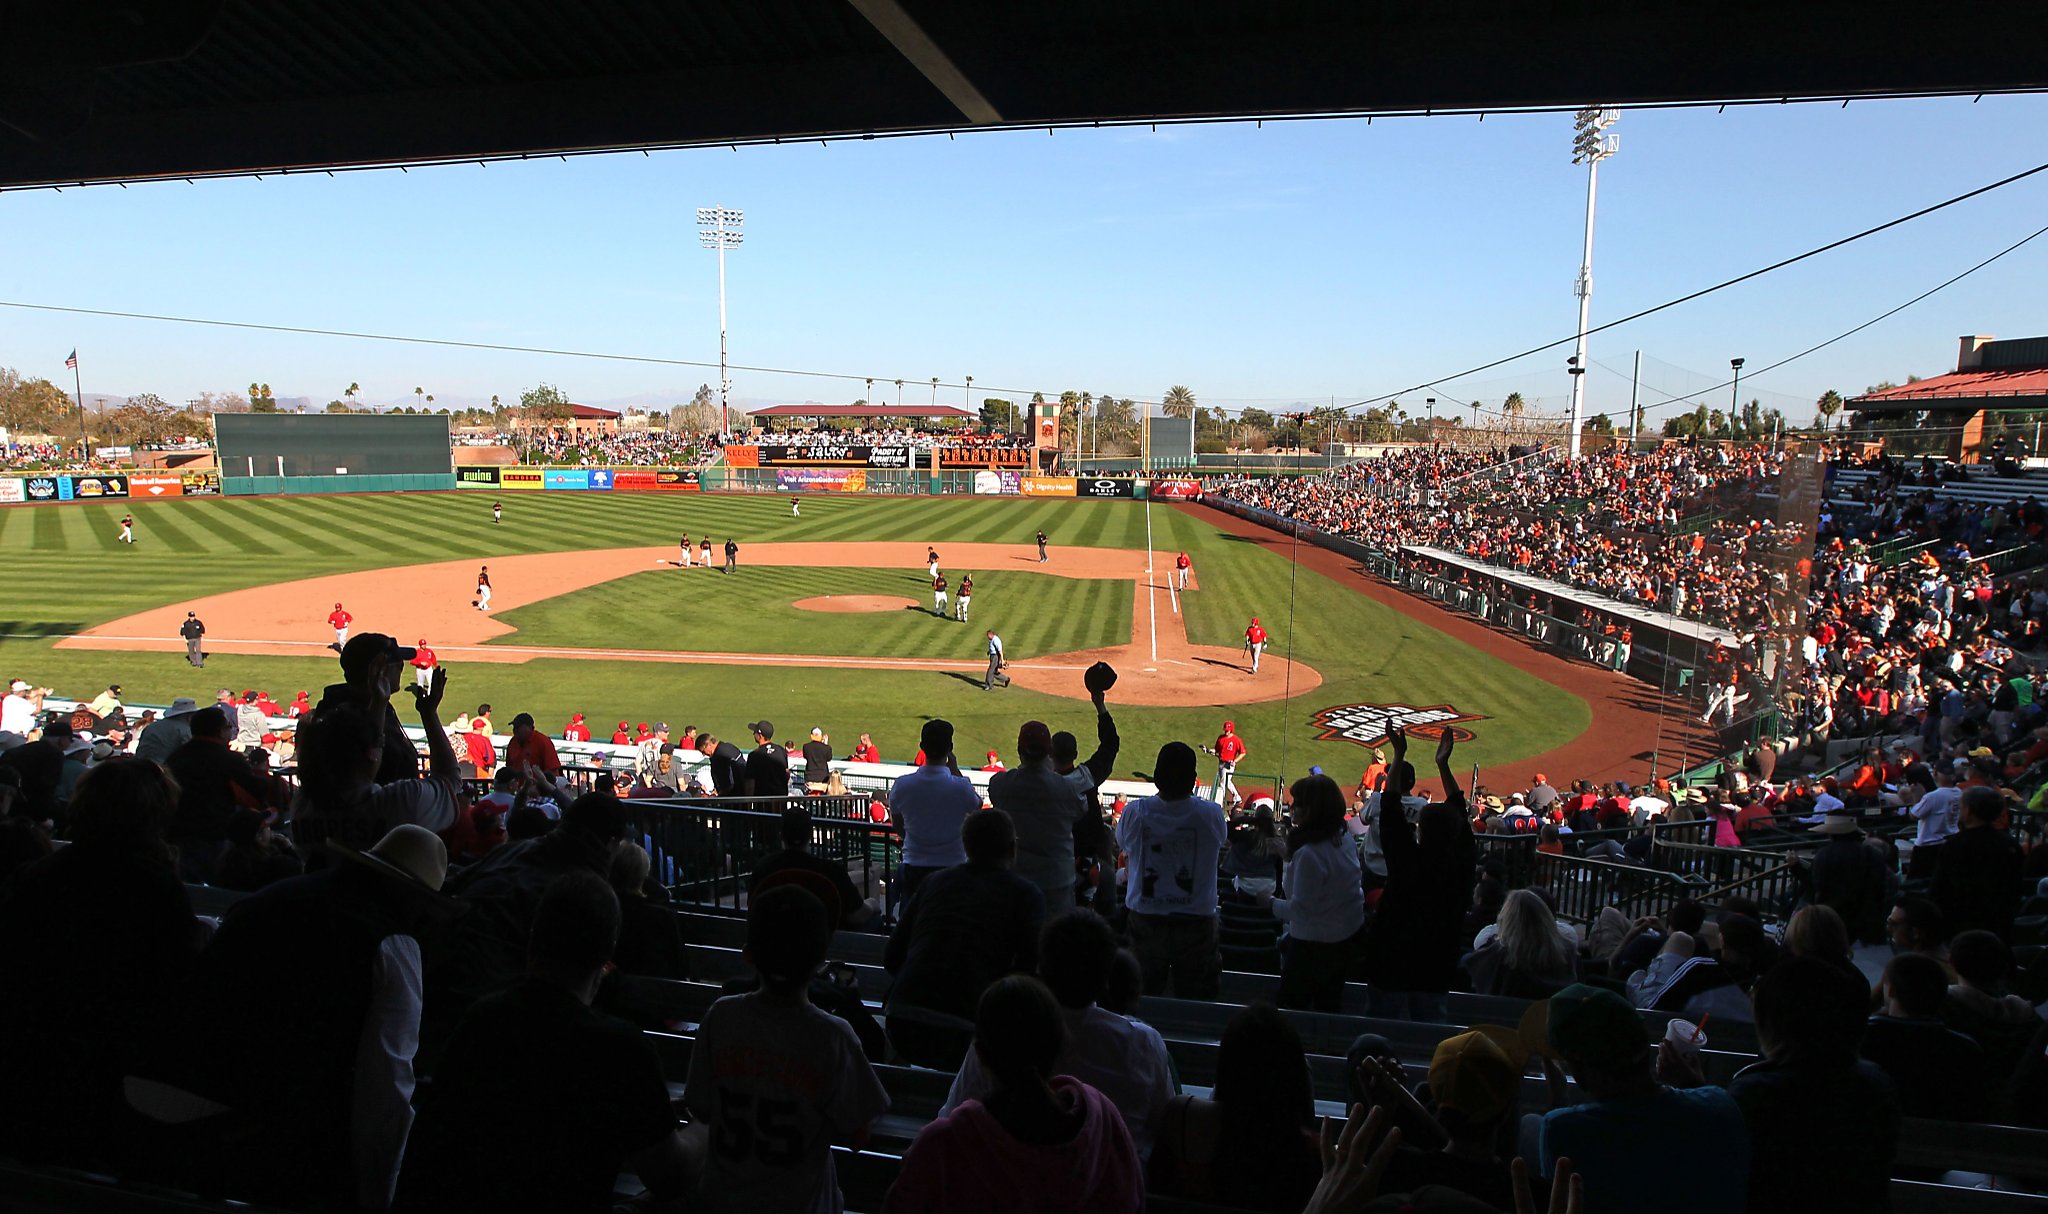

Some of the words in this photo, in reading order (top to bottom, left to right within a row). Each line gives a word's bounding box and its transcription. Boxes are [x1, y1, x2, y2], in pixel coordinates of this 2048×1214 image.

[726, 449, 758, 457] KELLY'S
[871, 446, 896, 456] PADDY
[868, 455, 907, 463] FURNITURE
[1326, 705, 1374, 718] 2012
[1326, 706, 1415, 728] WORLD
[72, 717, 93, 729] 28
[715, 1085, 803, 1165] 55
